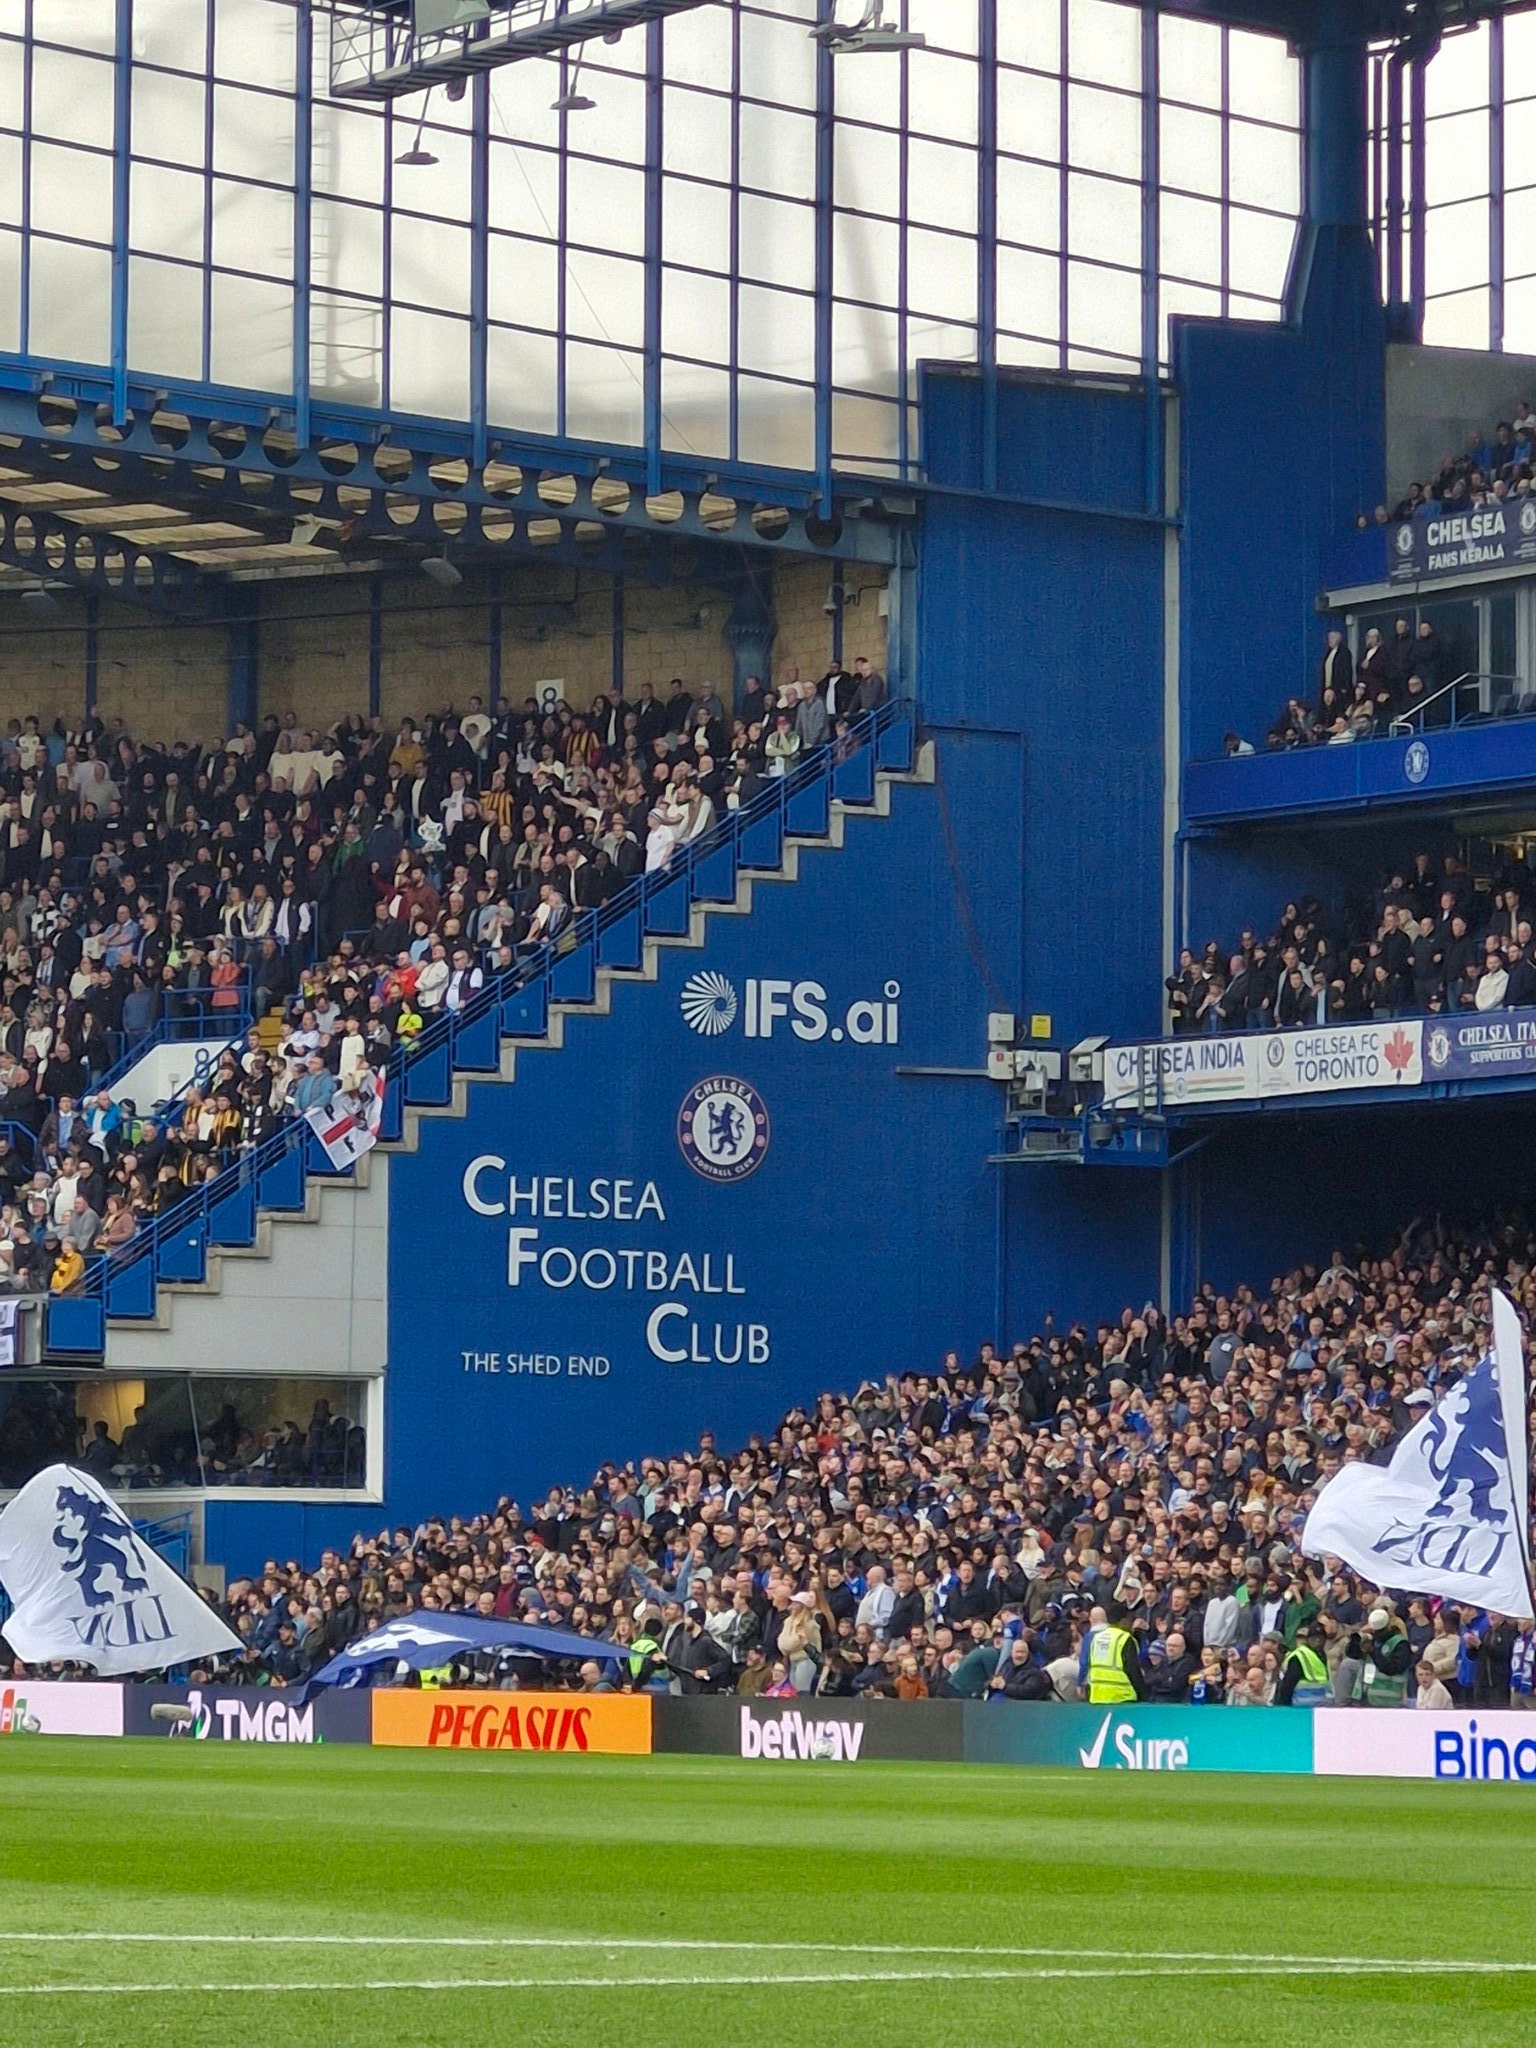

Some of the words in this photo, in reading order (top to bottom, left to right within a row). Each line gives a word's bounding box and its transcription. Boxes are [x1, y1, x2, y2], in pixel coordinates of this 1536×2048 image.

[1427, 511, 1506, 546] CHELSEA
[1428, 551, 1459, 571] FANS
[1460, 544, 1505, 566] KERALA
[744, 978, 901, 1045] IFS.ai
[1294, 1034, 1357, 1058] CHELSEA
[1361, 1033, 1379, 1052] FC
[1458, 1024, 1512, 1046] CHELSEA
[1117, 1045, 1196, 1078] CHELSEA
[1200, 1041, 1245, 1070] INDIA
[1294, 1054, 1379, 1083] TORONTO
[694, 1079, 753, 1103] CHELSEA
[461, 1352, 501, 1373] THE
[507, 1353, 561, 1376] SHED
[567, 1355, 610, 1376] END
[215, 1698, 314, 1744] TMGM
[428, 1704, 592, 1752] PEGASUS
[1115, 1723, 1189, 1770] Sure
